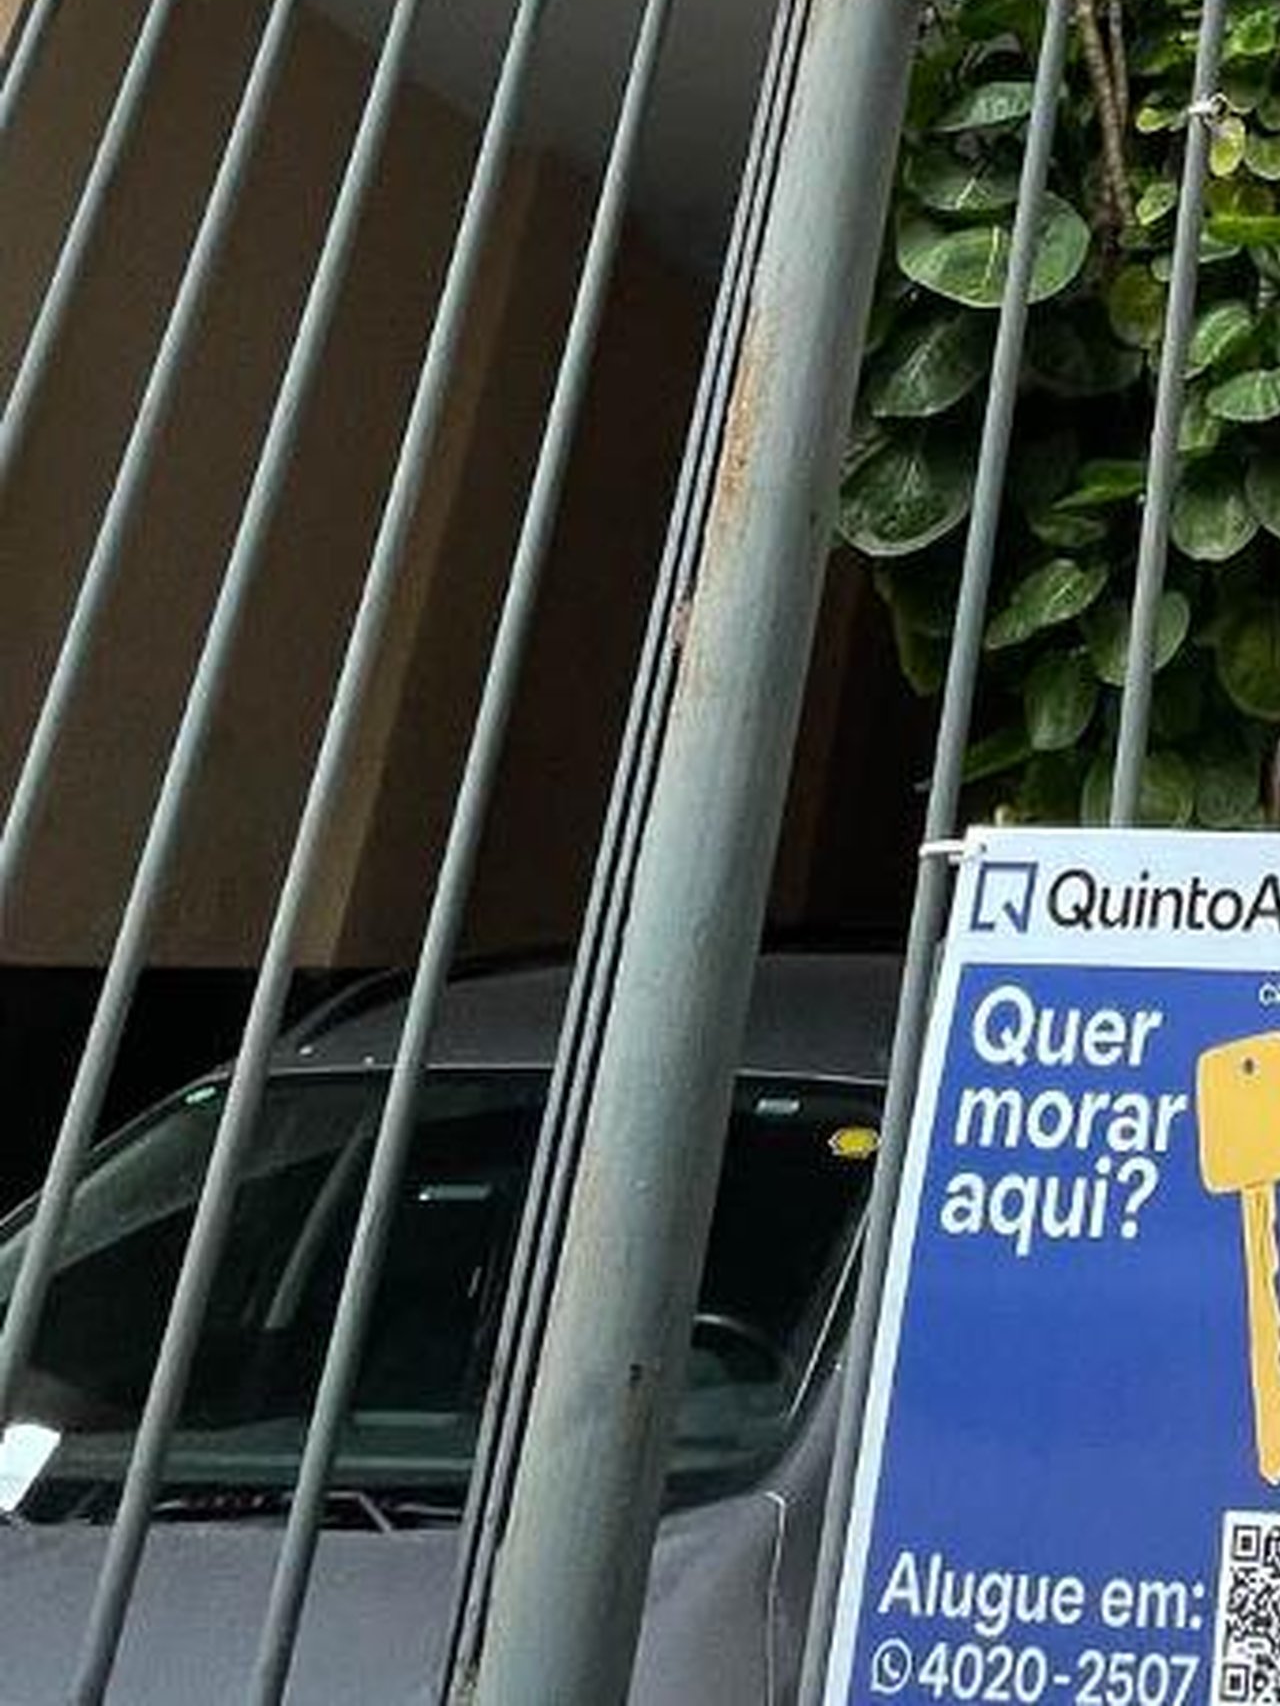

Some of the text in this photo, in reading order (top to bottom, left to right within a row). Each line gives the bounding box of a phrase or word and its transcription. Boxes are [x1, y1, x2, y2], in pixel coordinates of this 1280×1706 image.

[972, 984, 1163, 1068] Quer
[954, 1087, 1187, 1154] morar
[939, 1158, 1160, 1256] aqui?
[877, 1551, 1204, 1637] Alugue em:
